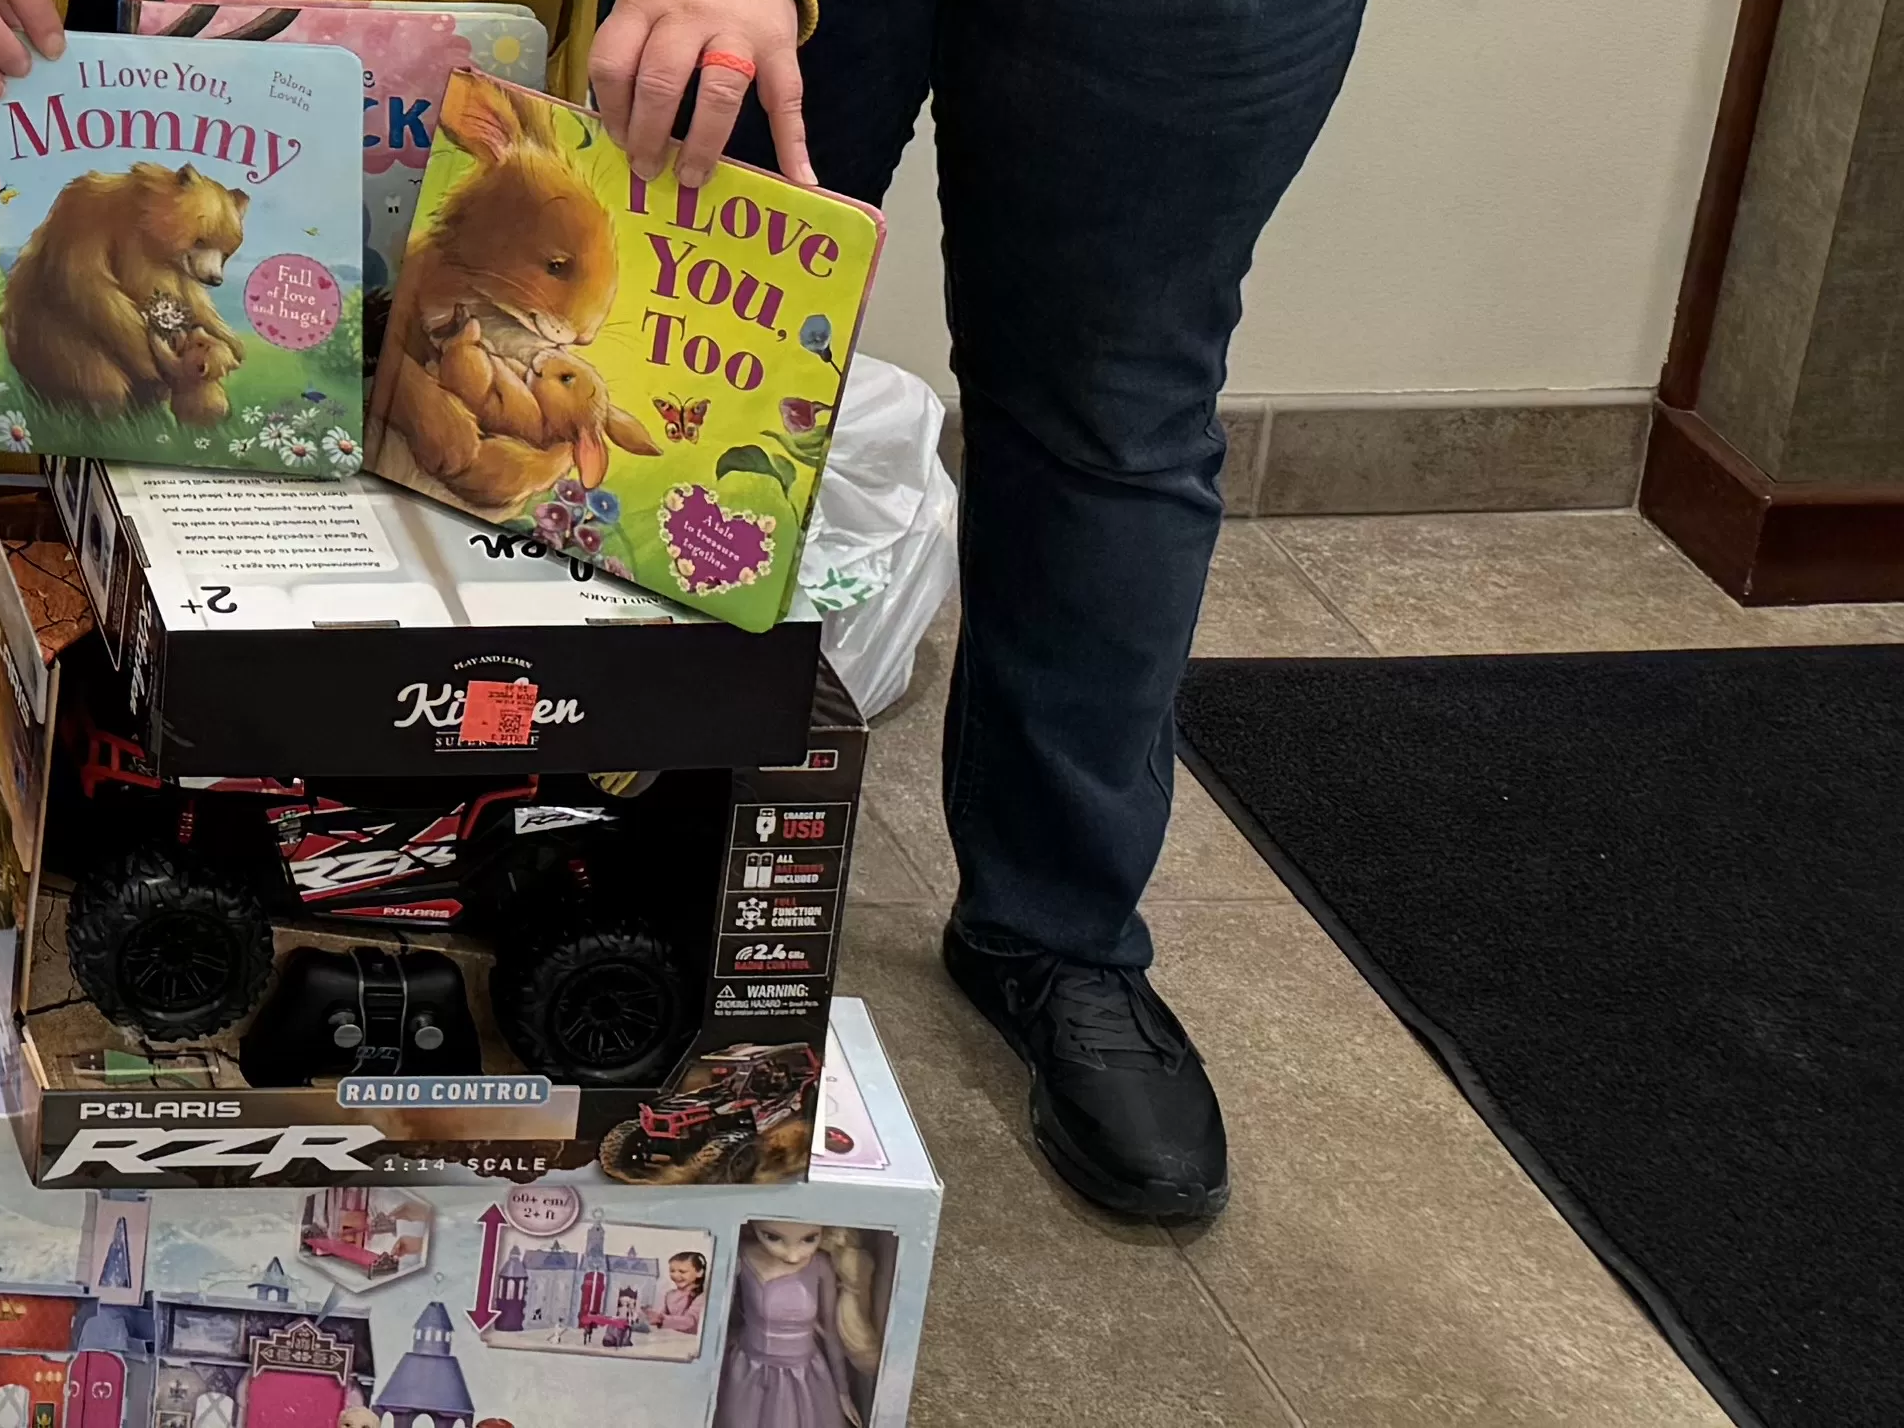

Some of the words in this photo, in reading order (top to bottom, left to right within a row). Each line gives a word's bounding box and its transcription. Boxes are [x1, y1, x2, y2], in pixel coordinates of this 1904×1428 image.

[78, 60, 90, 89] I
[97, 58, 170, 91] Love
[173, 62, 234, 105] You,
[2, 93, 303, 186] Mommy
[624, 167, 651, 216] I
[667, 181, 841, 279] Love
[277, 264, 314, 289] Full
[643, 231, 789, 343] You,
[267, 286, 280, 299] of
[282, 287, 317, 307] love
[252, 303, 275, 317] and
[278, 304, 327, 329] hugs!
[641, 306, 765, 393] Too
[702, 513, 714, 527] A
[683, 520, 695, 533] to
[695, 526, 741, 563] treasure
[682, 536, 728, 574] together
[180, 584, 239, 616] 2+
[783, 820, 826, 840] USB
[773, 874, 820, 885] INCLUDED
[771, 917, 818, 928] CONTROL
[772, 906, 823, 917] FUNCTION
[747, 983, 810, 998] WARNING:
[345, 1083, 419, 1103] RADIO
[430, 1083, 543, 1102] CONTROL
[79, 1101, 242, 1120] POLARIS
[41, 1124, 387, 1182] RZR
[382, 1158, 446, 1172] 1:14
[467, 1157, 547, 1173] SCALE
